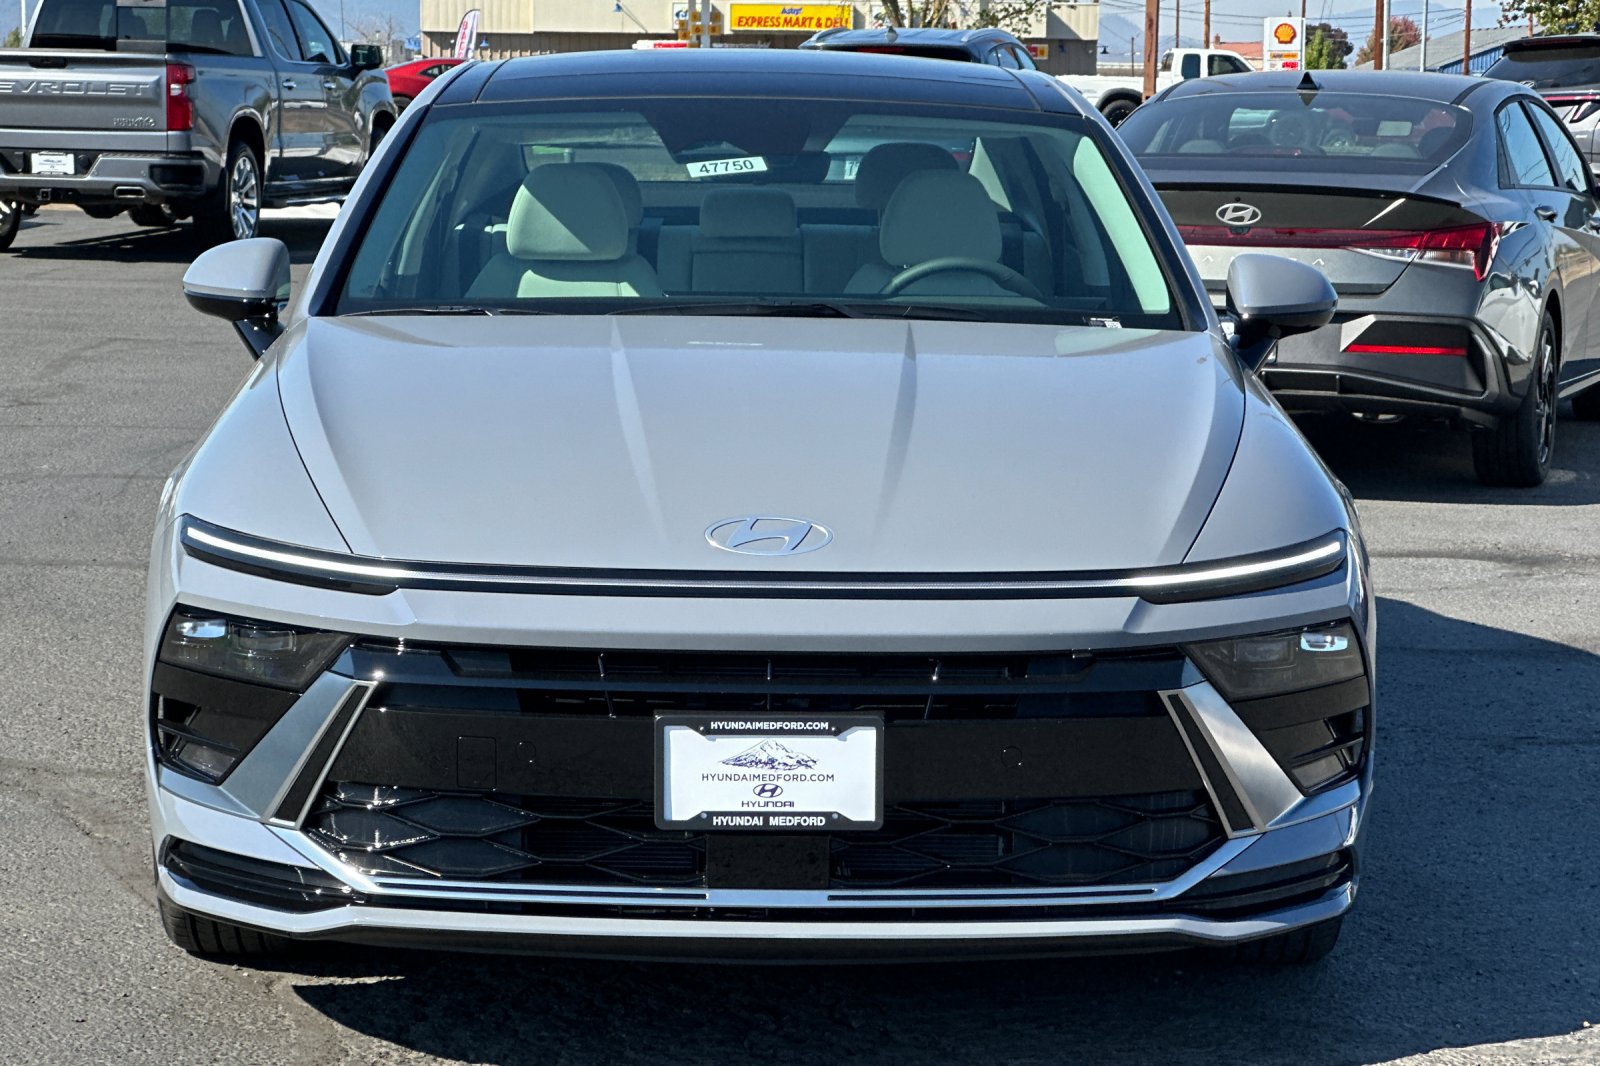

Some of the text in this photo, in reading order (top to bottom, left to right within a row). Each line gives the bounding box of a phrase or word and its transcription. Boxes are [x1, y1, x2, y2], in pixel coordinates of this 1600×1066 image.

[738, 16, 780, 28] EXPRESS
[782, 16, 814, 28] MART
[815, 16, 822, 28] &
[699, 158, 755, 175] 47750
[710, 721, 829, 731] HYUNDAIMEDFORD.COM
[701, 773, 835, 783] HYUNDAIMEDFORD.COM
[741, 800, 795, 808] HYUNDAI
[712, 816, 826, 827] HYUNDAI MEDFORD
